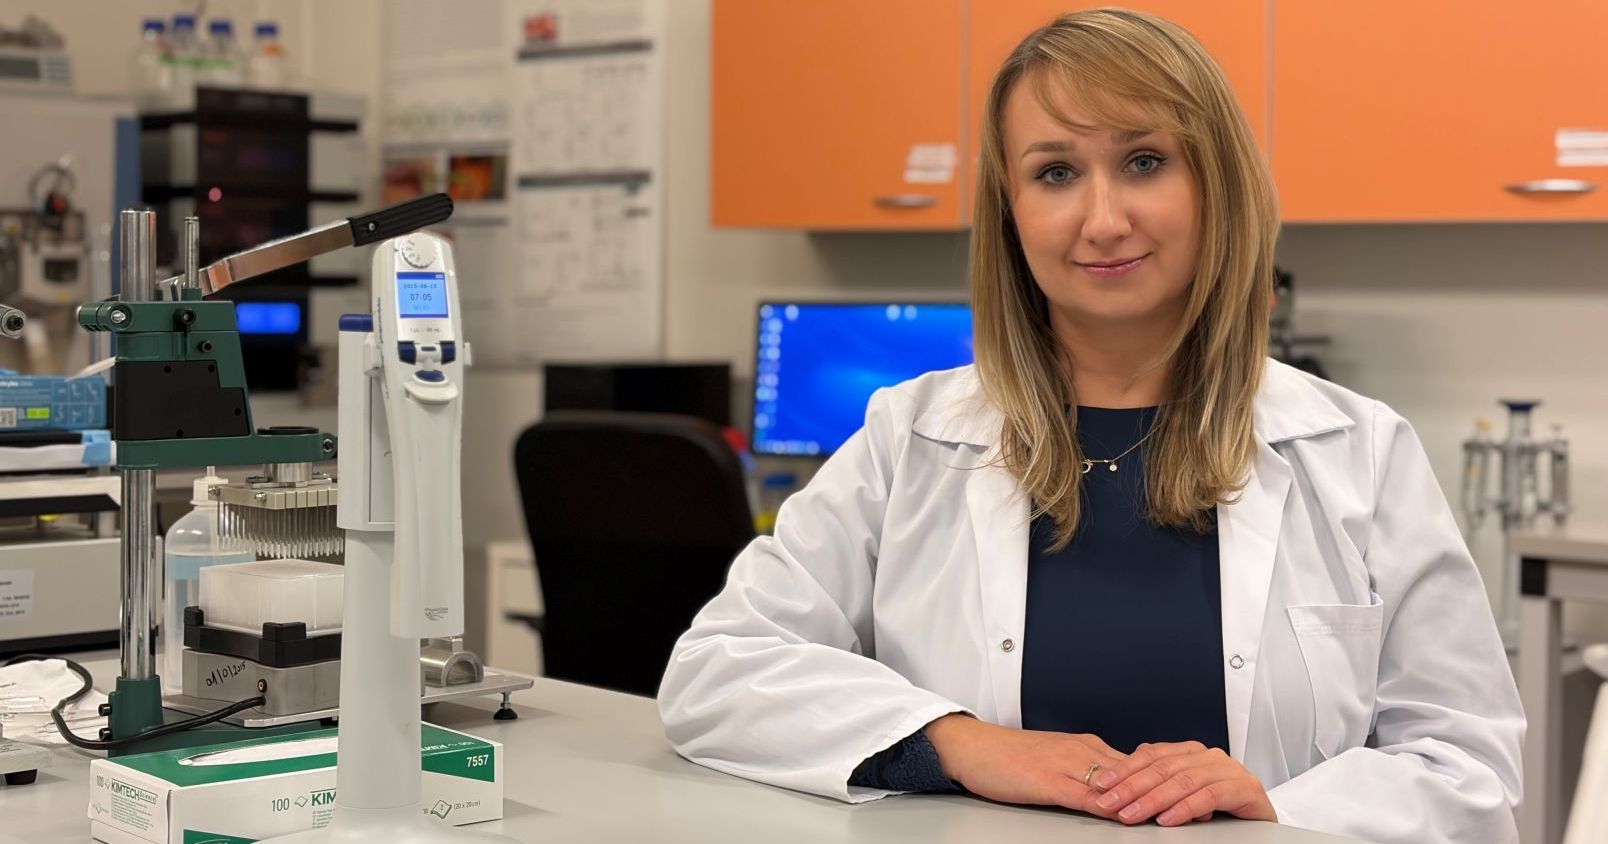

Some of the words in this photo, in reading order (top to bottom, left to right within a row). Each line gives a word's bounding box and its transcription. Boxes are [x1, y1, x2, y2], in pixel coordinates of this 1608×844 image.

[466, 754, 489, 768] 7557
[112, 780, 140, 801] KIMTECH
[272, 798, 290, 812] 100
